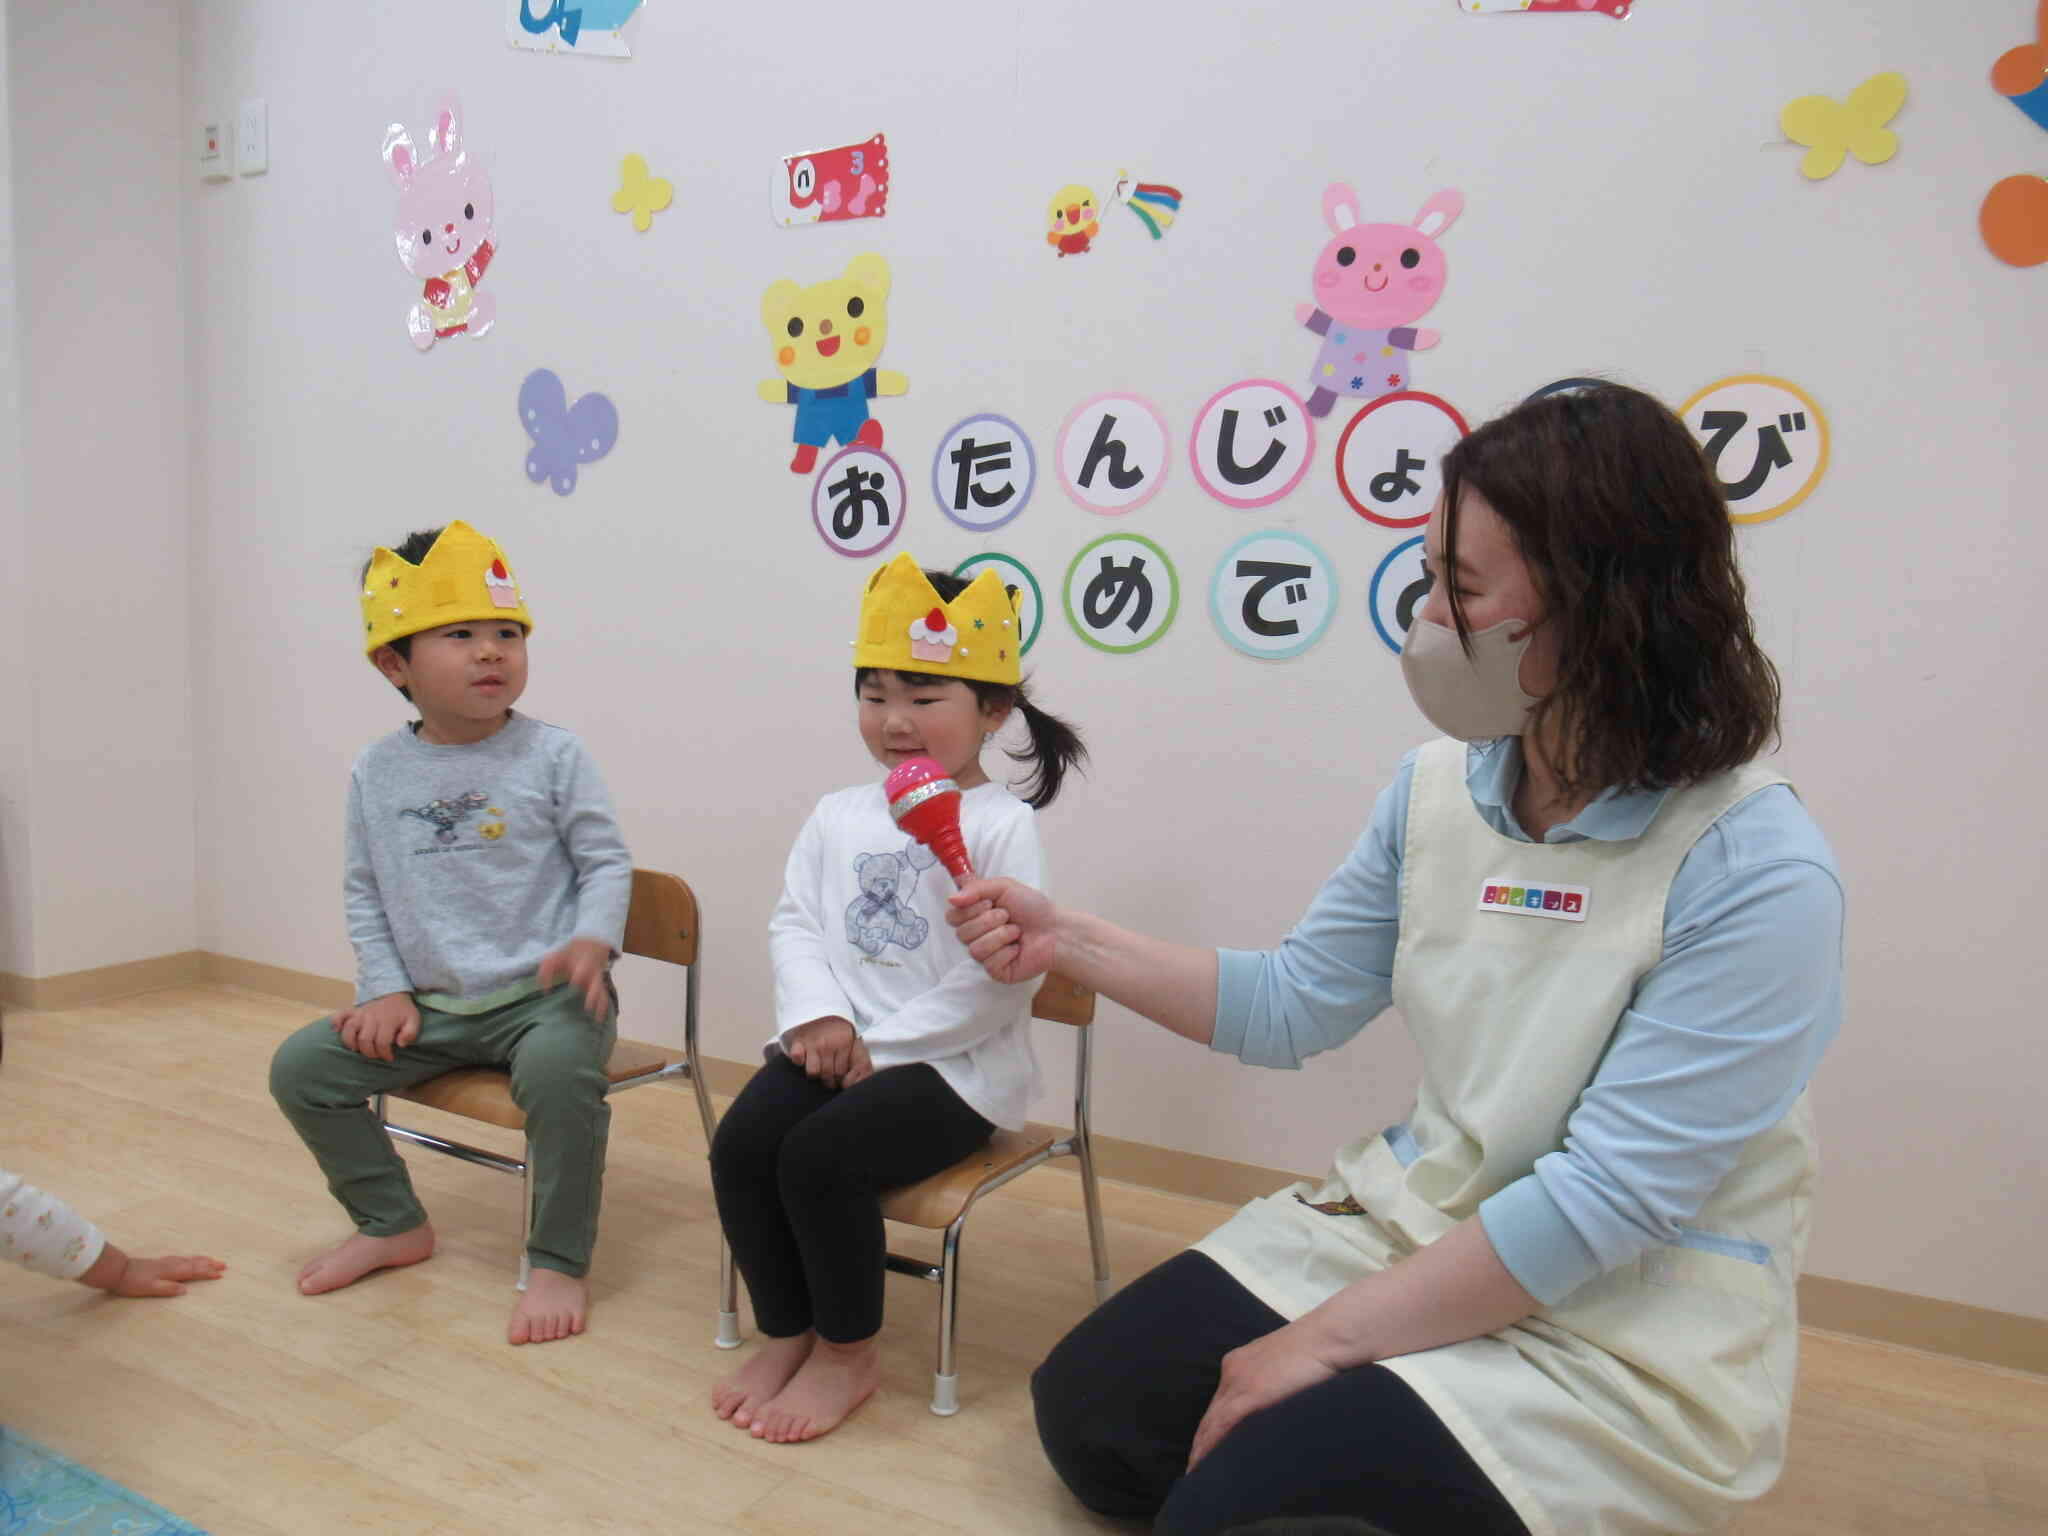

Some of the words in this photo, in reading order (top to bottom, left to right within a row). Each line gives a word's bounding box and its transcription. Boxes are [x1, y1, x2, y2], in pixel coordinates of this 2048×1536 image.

[828, 405, 1806, 540] おたんじょび
